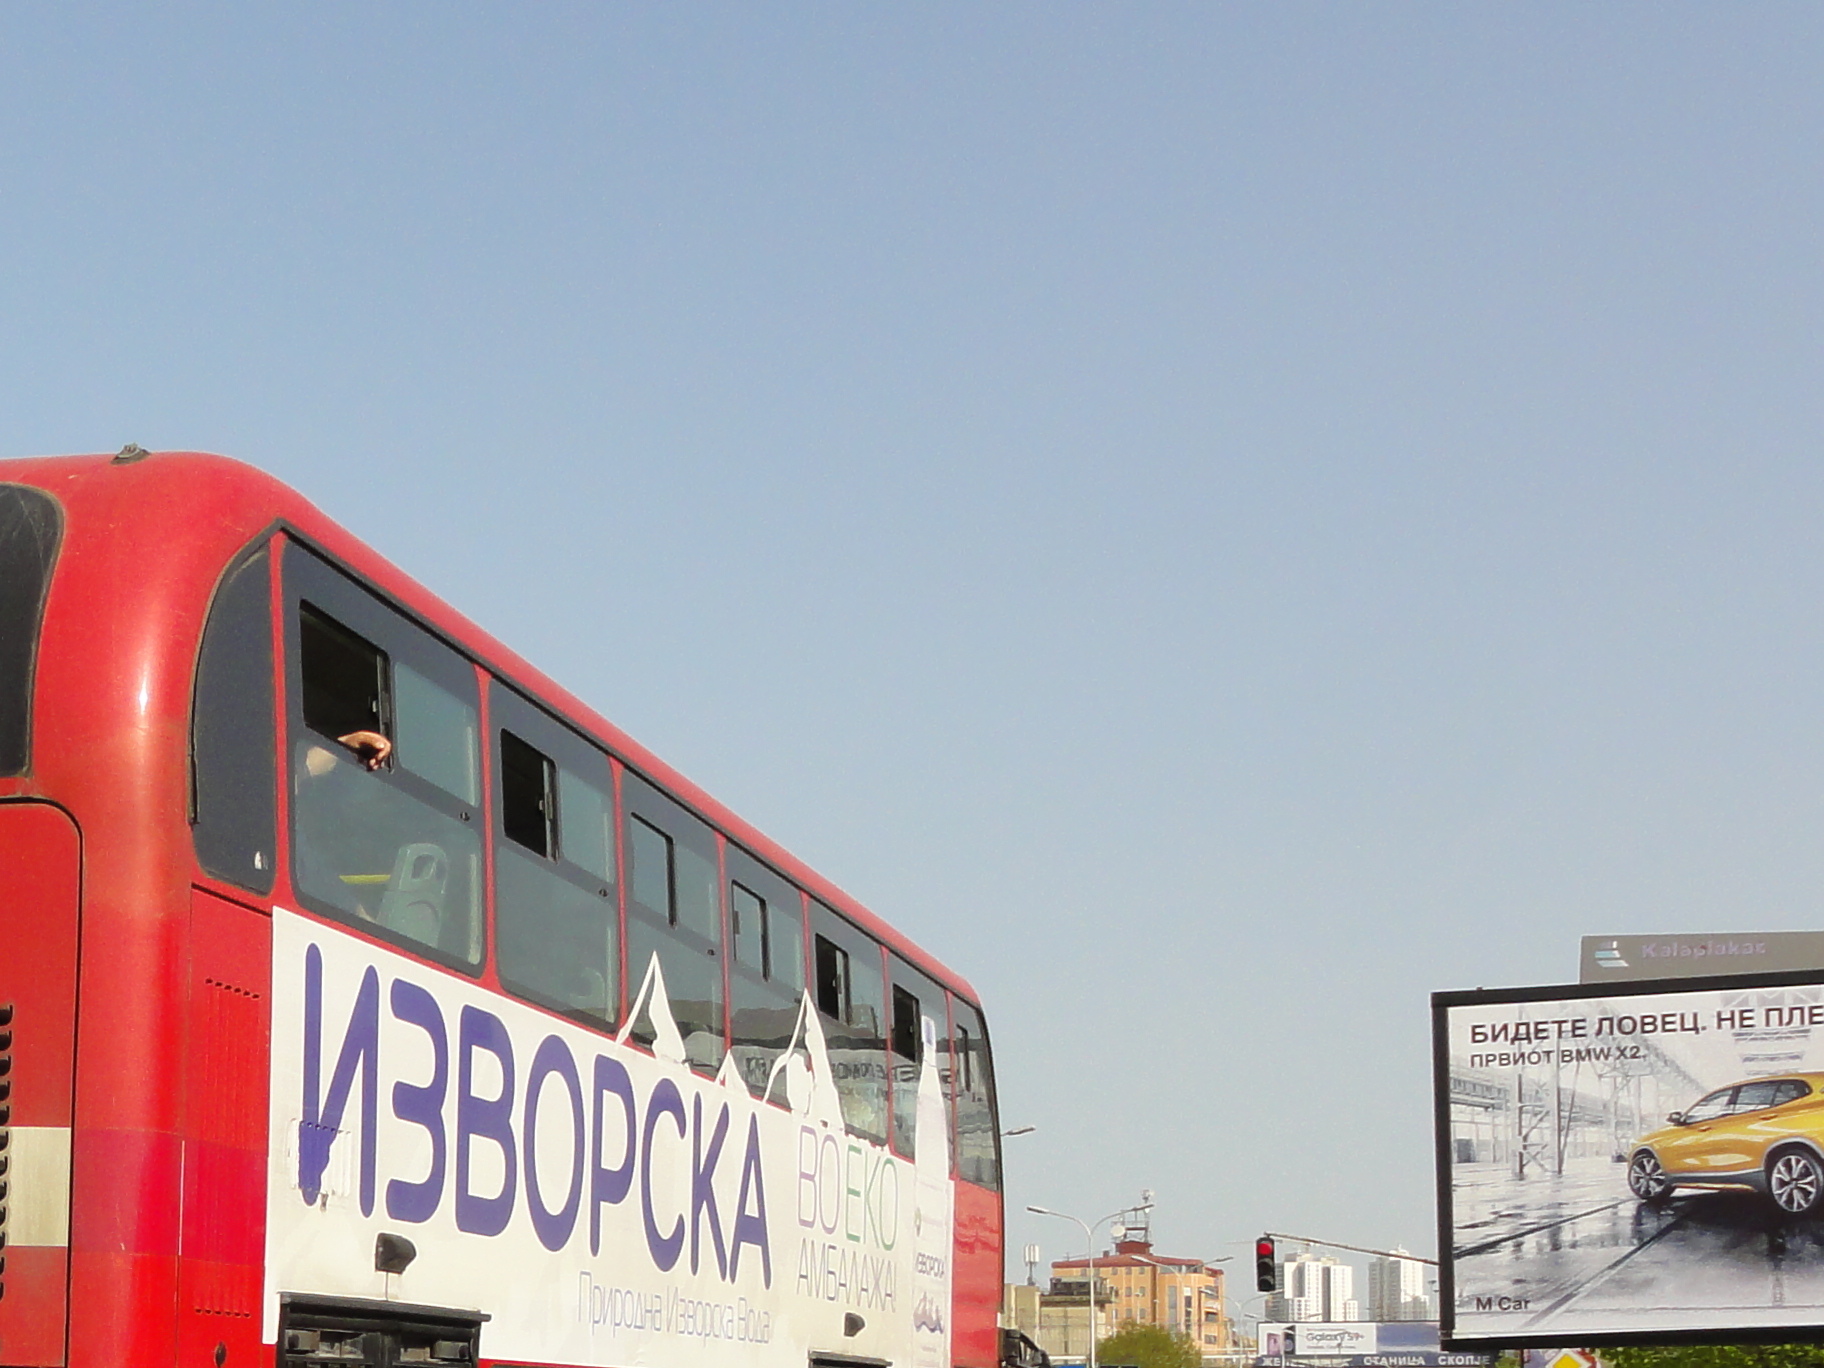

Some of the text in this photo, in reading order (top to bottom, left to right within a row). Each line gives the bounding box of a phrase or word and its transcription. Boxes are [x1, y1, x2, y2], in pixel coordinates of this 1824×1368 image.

[1470, 1004, 1824, 1046] БИДЕТЕ ЛОВЕЦ. НЕ ПЛЕ
[1470, 1050, 1556, 1068] ПРВИОТ
[1561, 1047, 1612, 1064] BMW
[299, 942, 772, 1290] ИЗВОРСКА
[578, 1271, 771, 1347] Природна Изворска Вода
[1476, 1296, 1531, 1311] M Car
[1306, 1331, 1345, 1344] Galaxy
[1363, 1356, 1426, 1367] СТАНИЦА
[1437, 1355, 1491, 1367] СКОПЈЕ
